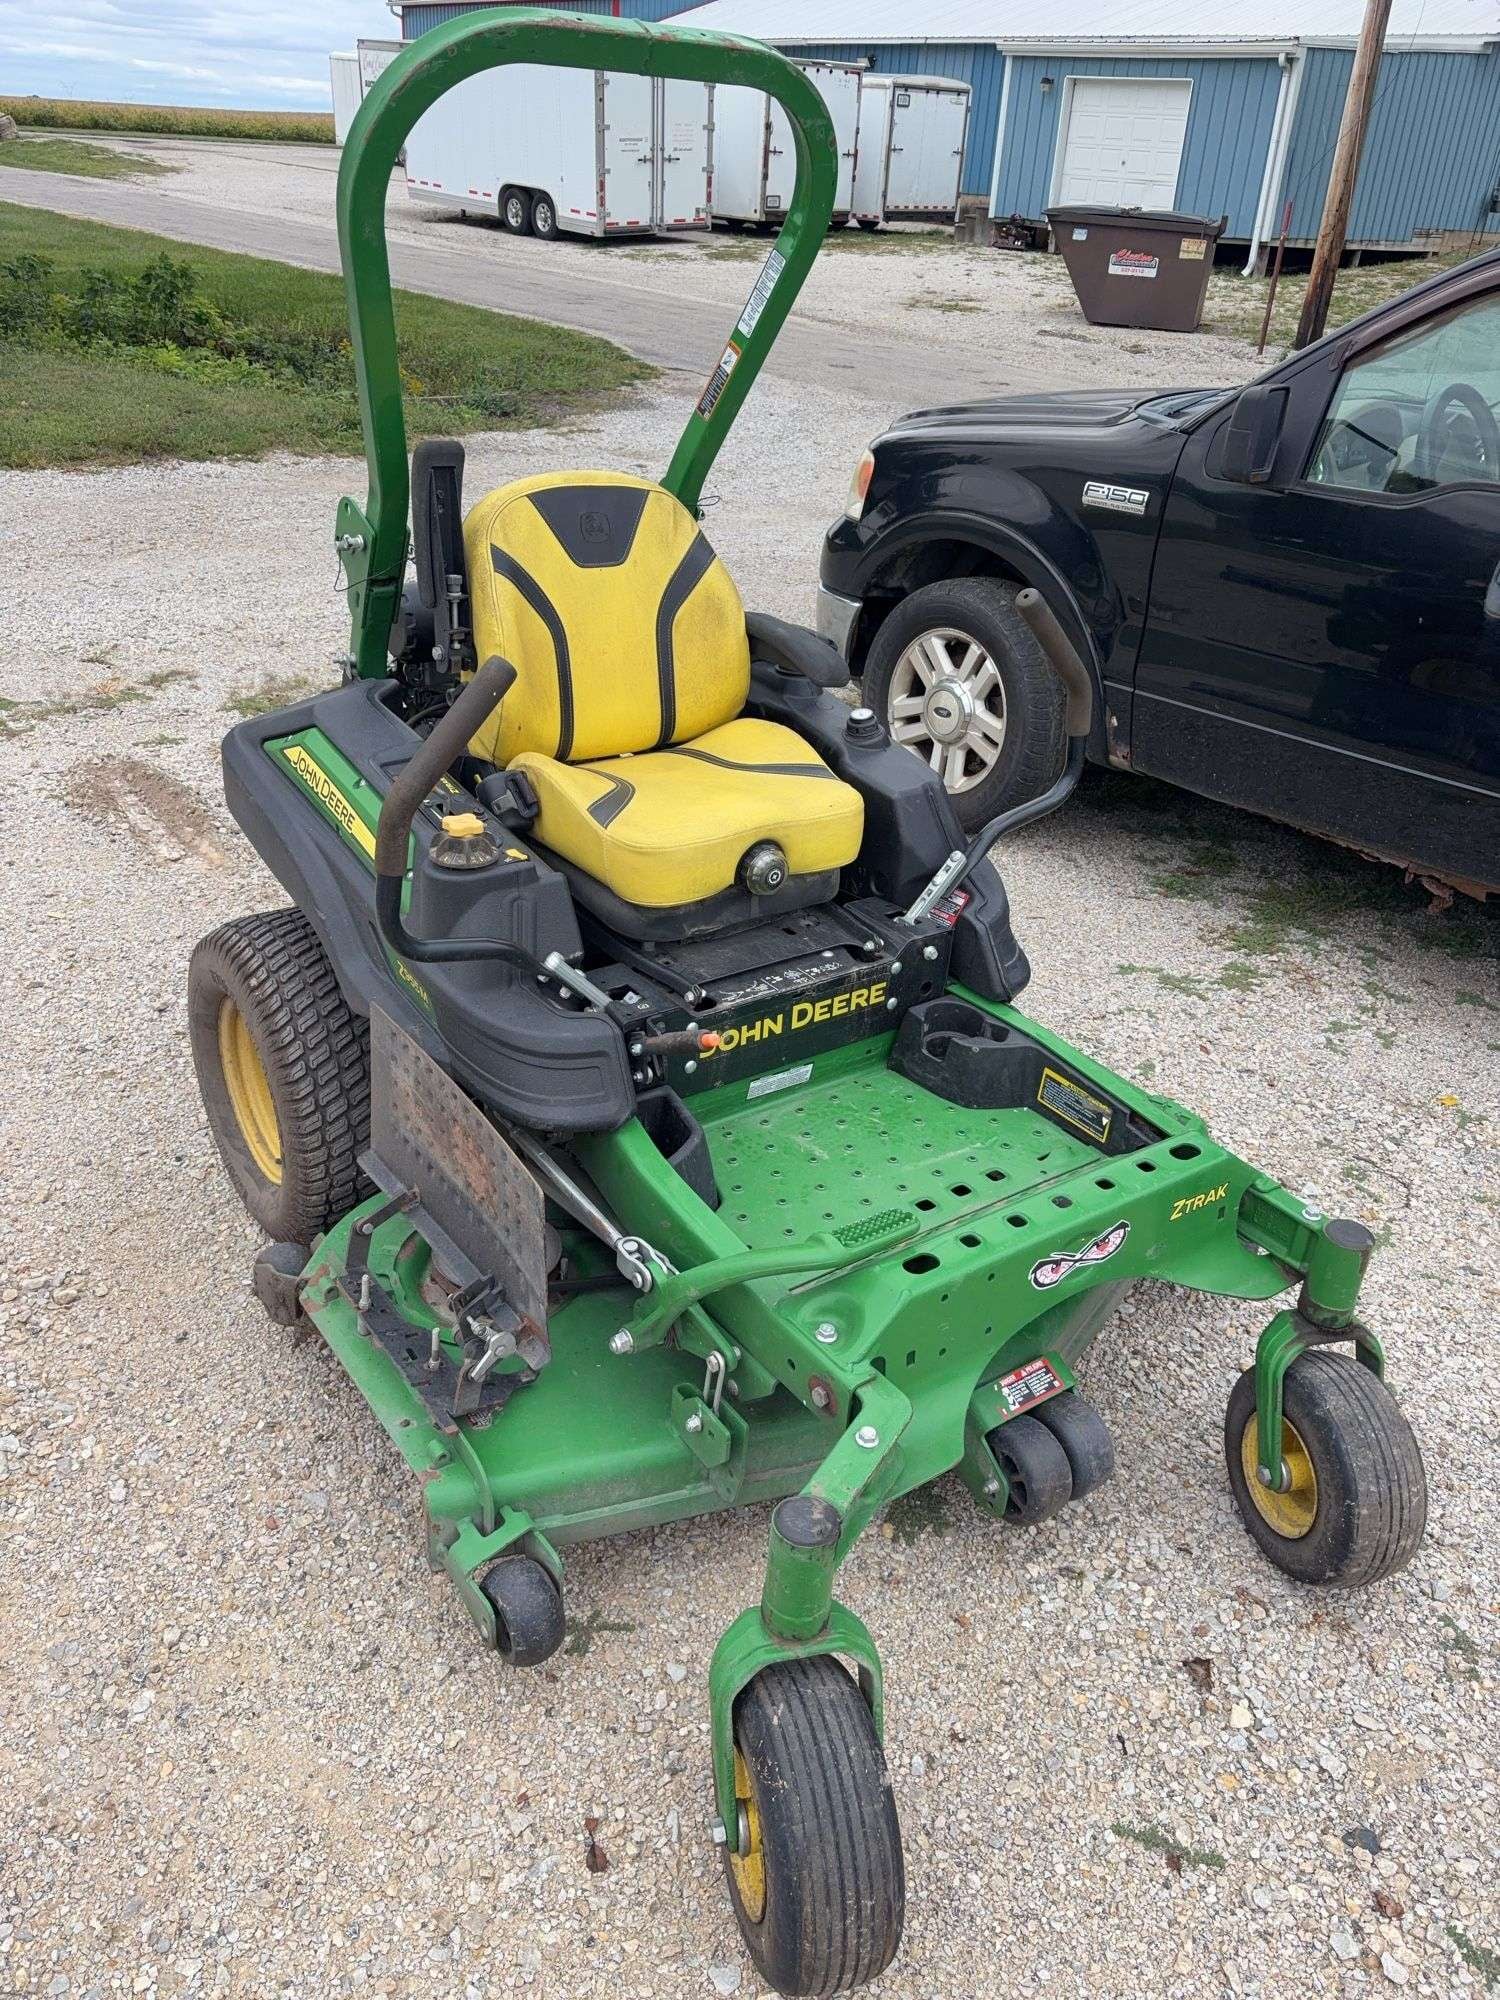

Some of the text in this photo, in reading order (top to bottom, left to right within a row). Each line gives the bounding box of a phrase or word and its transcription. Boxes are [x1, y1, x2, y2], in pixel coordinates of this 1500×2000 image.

[292, 750, 356, 832] JOHN DEERE
[791, 981, 887, 1030] DEERE
[1170, 1182, 1229, 1221] ZTRAK
